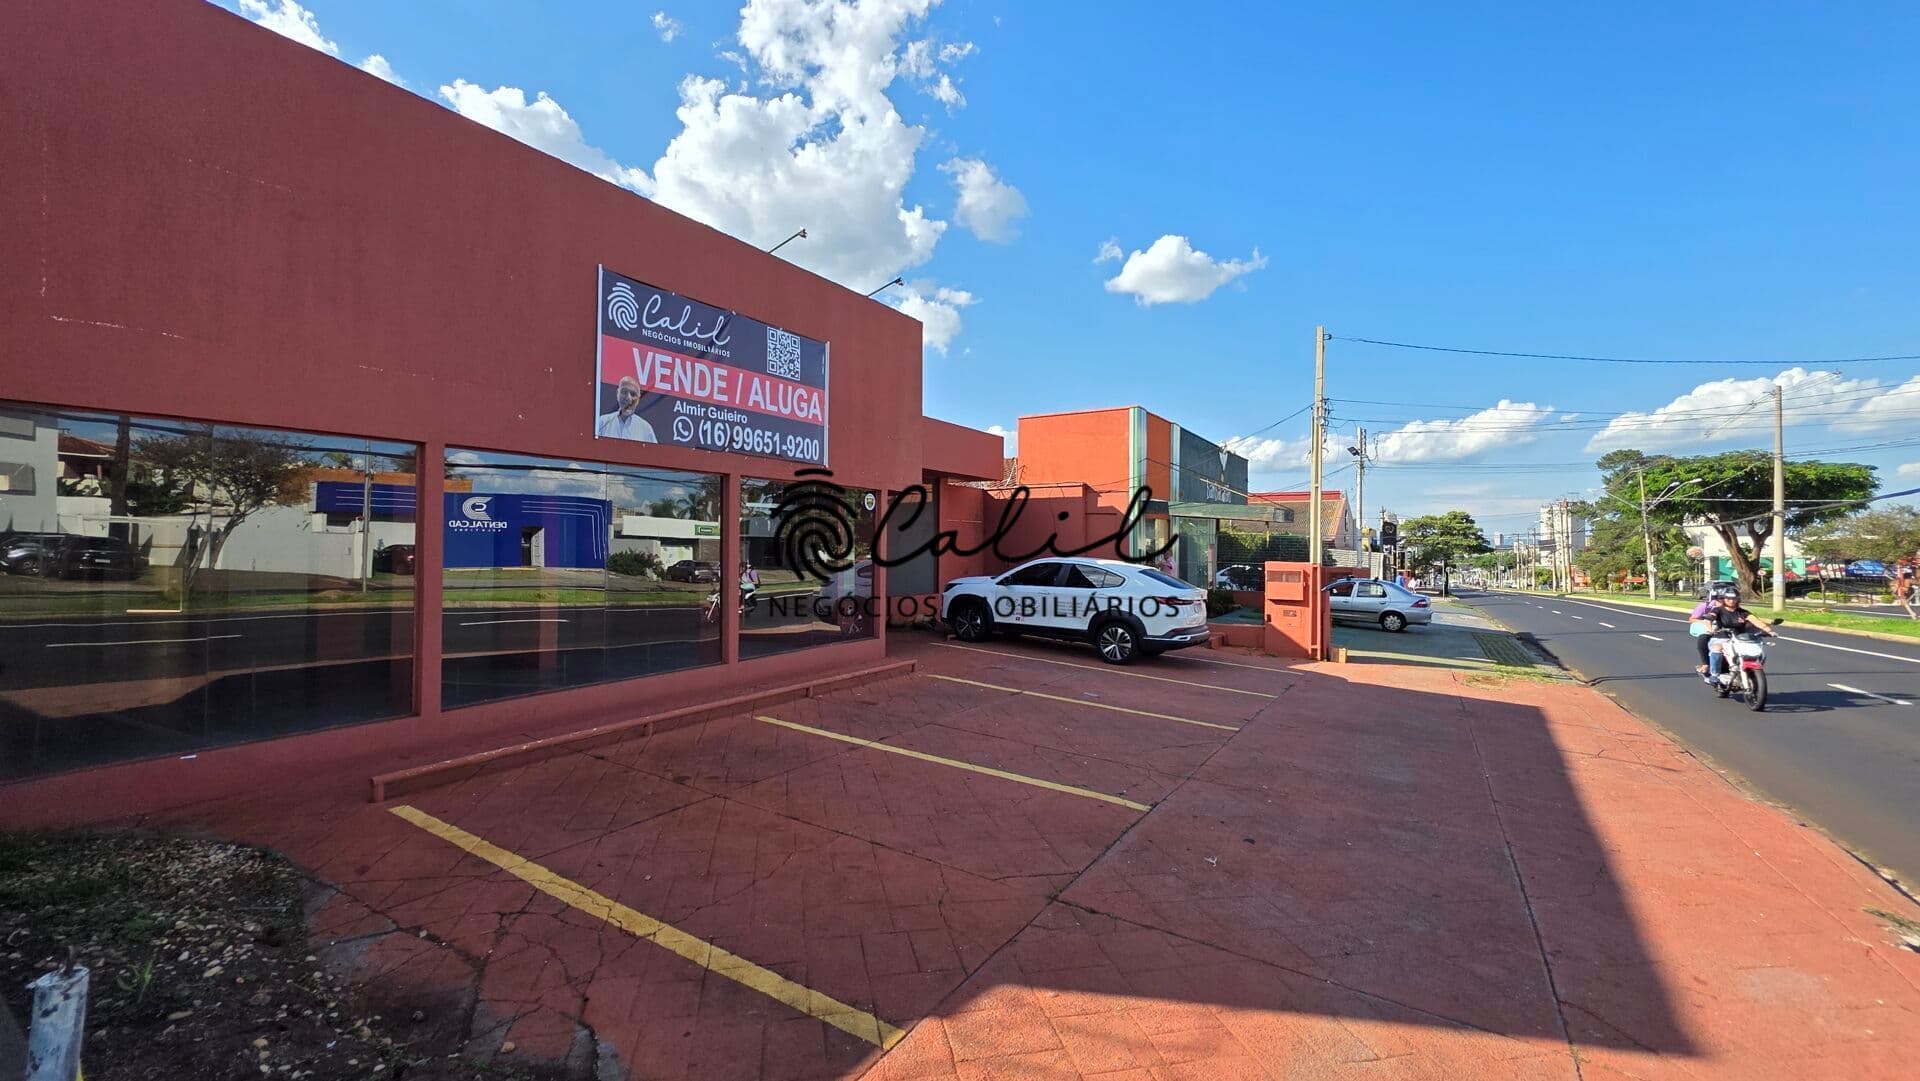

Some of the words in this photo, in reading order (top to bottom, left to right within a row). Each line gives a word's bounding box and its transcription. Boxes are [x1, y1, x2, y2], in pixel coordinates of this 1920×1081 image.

[641, 328, 681, 345] NEGÓCIOS
[642, 294, 731, 346] Calil
[632, 347, 728, 402] VENDE
[735, 373, 744, 404] /
[748, 376, 823, 422] ALUGA
[673, 400, 706, 417] Almir
[708, 406, 748, 424] Guieiro
